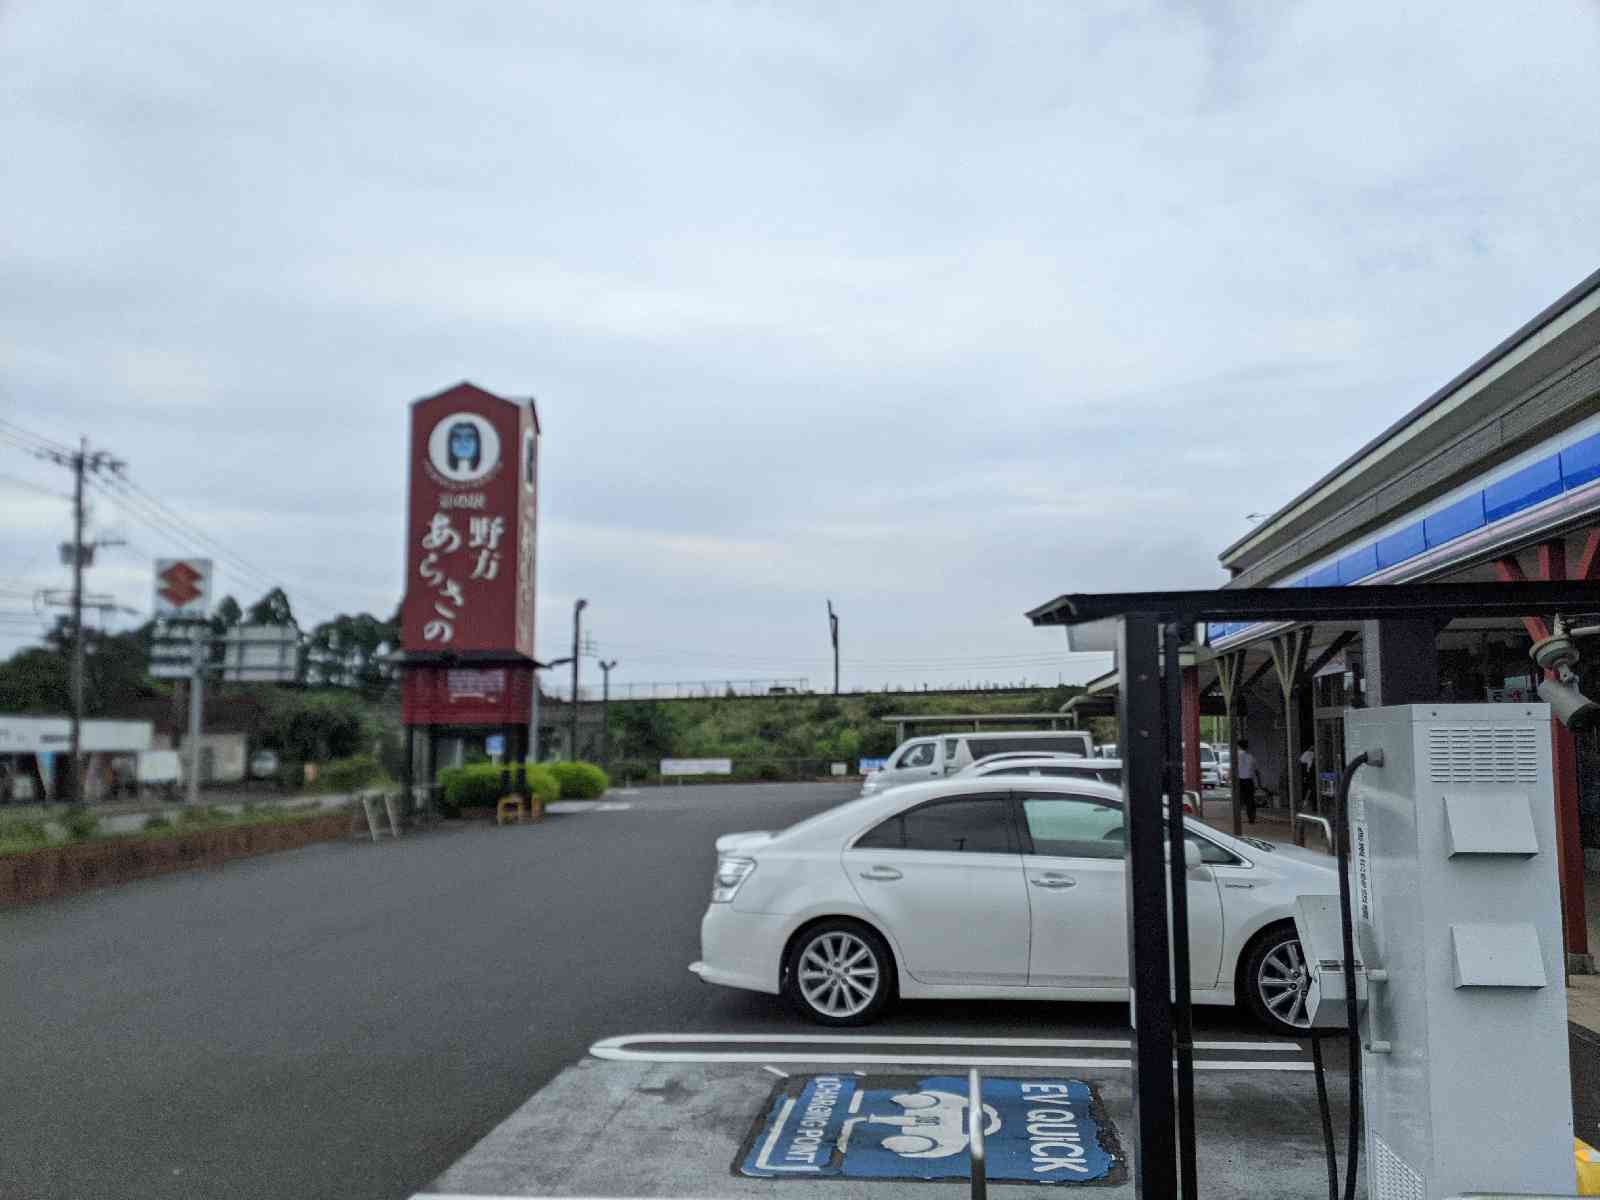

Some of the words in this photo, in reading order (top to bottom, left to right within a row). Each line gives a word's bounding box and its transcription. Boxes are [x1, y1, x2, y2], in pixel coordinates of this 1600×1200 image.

[420, 512, 464, 642] あらさの
[801, 1080, 842, 1127] CHARGING
[1021, 1083, 1071, 1105] EV
[785, 1128, 822, 1163] POINT
[1026, 1109, 1088, 1173] QUICK
